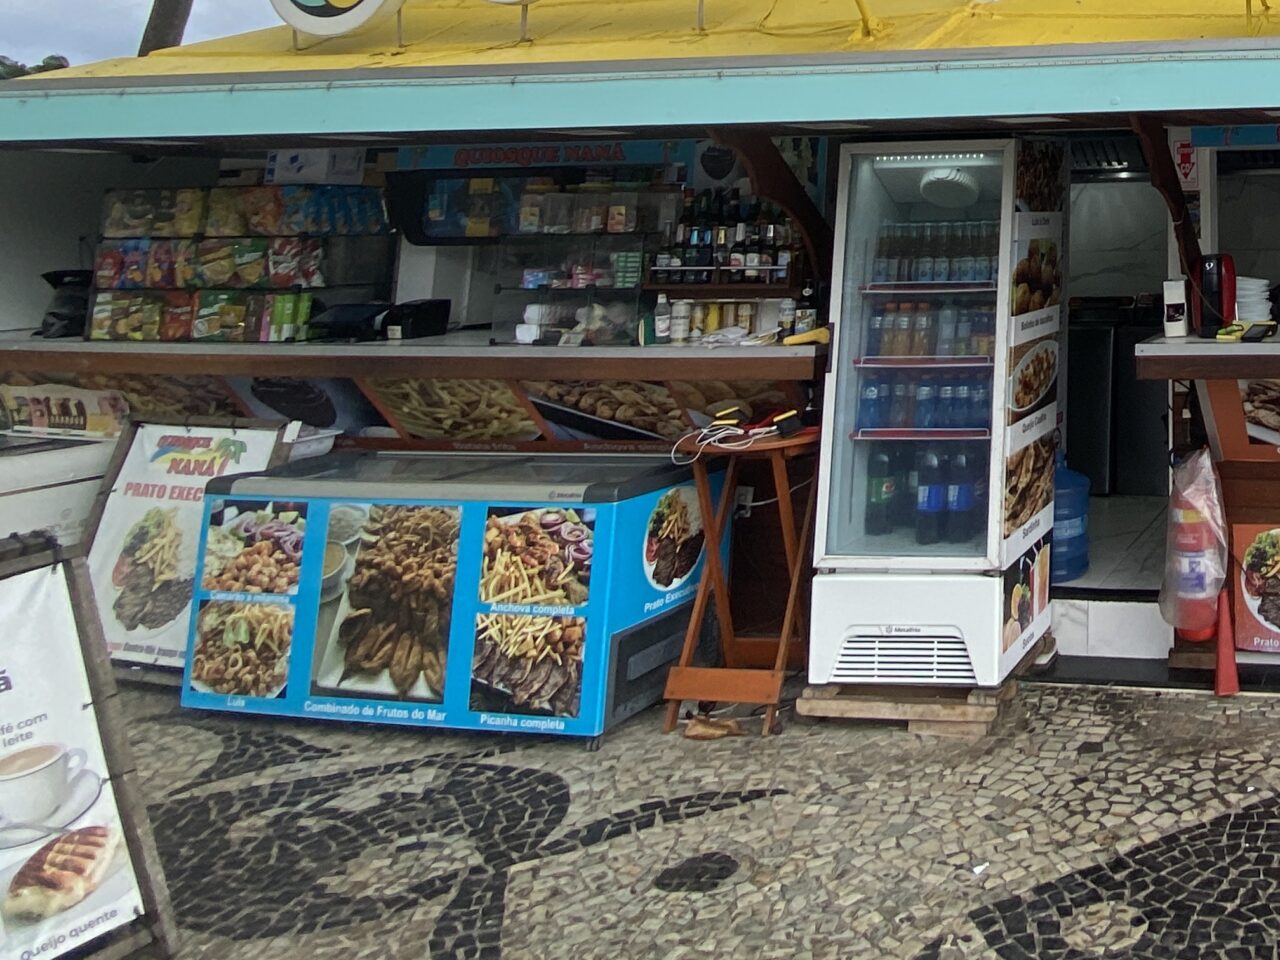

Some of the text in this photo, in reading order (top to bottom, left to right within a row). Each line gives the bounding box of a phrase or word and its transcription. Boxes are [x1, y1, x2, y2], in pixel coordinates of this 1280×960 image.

[123, 482, 204, 502] PRATO EXEC
[490, 602, 575, 616] Anchova completa
[1253, 637, 1279, 647] Prato
[227, 696, 245, 707] Lula
[304, 700, 446, 721] Combinado de Frutos do Mar
[17, 713, 48, 730] com
[480, 714, 565, 730] Picanha completa
[3, 730, 33, 747] leite
[69, 908, 118, 938] quente
